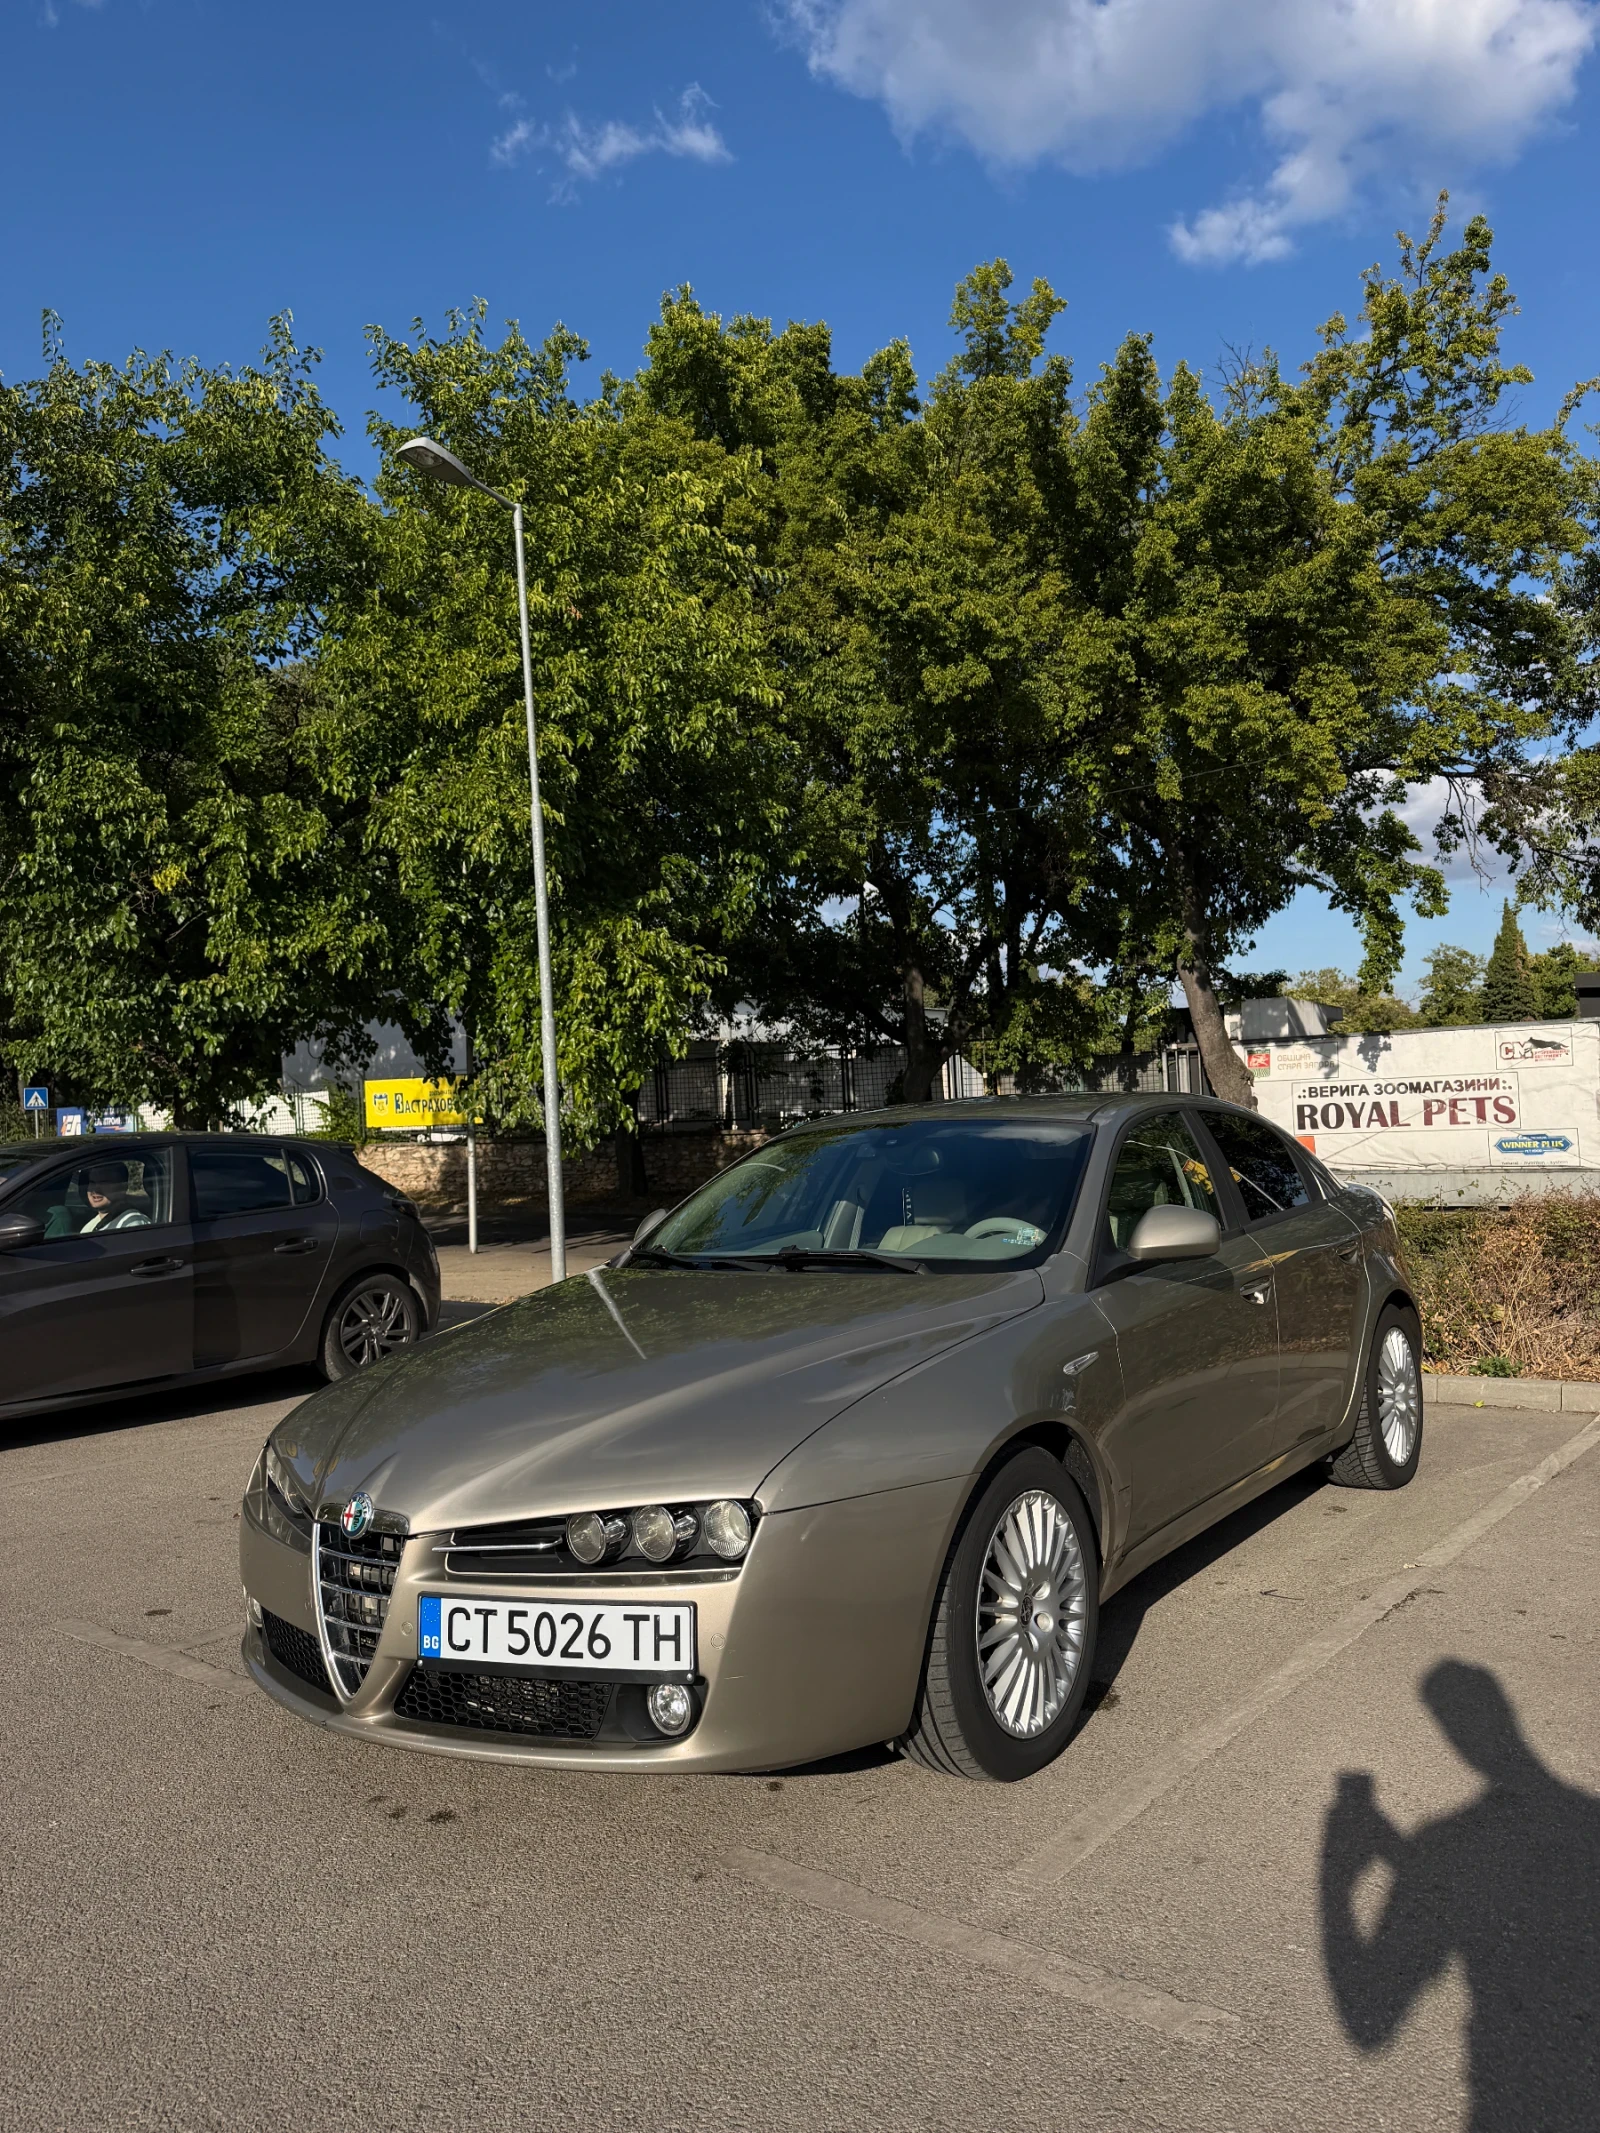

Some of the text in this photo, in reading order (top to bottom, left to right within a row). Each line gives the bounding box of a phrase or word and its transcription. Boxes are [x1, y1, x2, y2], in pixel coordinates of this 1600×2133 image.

[1277, 1053, 1311, 1062] ОБЩИНА
[1277, 1060, 1335, 1071] СТАРА ЗАГОРА
[1296, 1095, 1517, 1130] ROYAL PETS
[1501, 1140, 1564, 1149] WINNER PLUS
[447, 1606, 681, 1662] CT 5026 TH
[423, 1635, 440, 1649] BG
